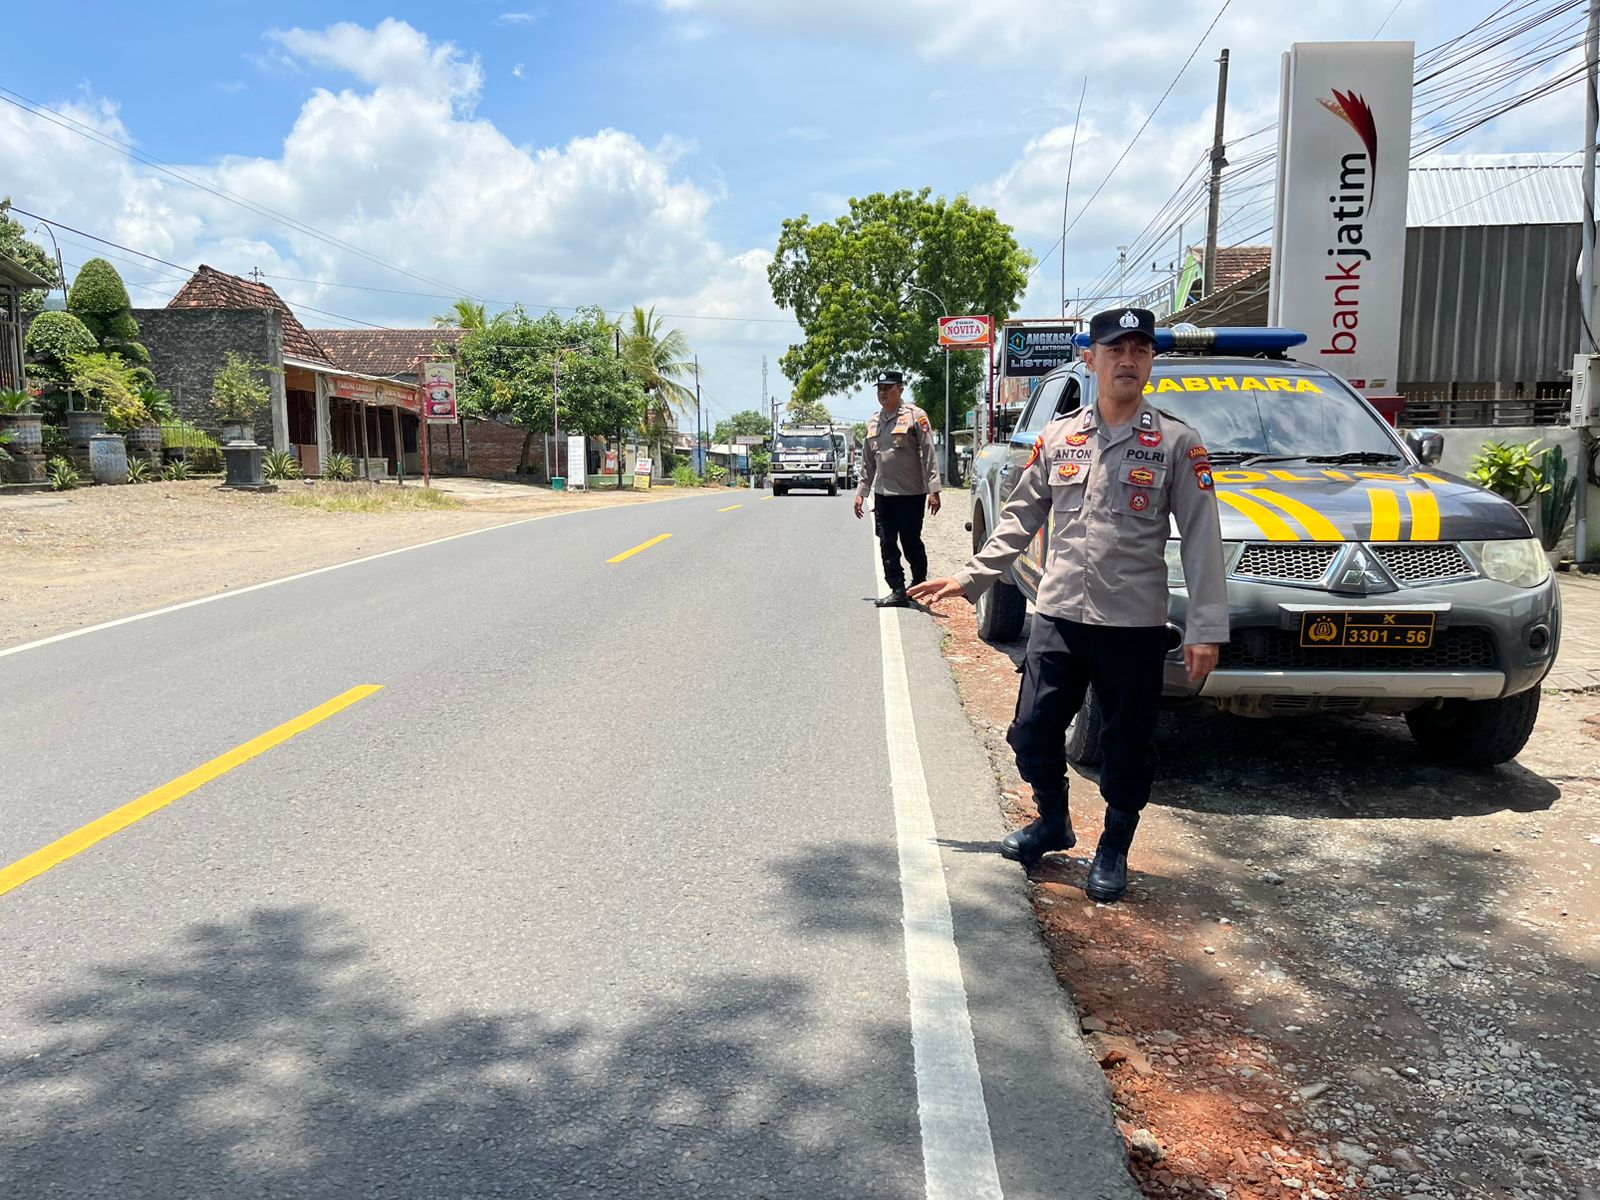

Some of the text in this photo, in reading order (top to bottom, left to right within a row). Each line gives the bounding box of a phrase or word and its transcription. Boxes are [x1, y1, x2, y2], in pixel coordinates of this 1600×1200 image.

[947, 325, 981, 335] NOVITA
[1026, 333, 1071, 345] ANGKASA
[1010, 359, 1067, 368] LISTRIK
[1055, 449, 1092, 460] ANTON
[1126, 449, 1164, 462] POLRI
[1212, 470, 1450, 485] OLISI
[1349, 629, 1388, 643] 3301
[1406, 630, 1427, 643] 56
